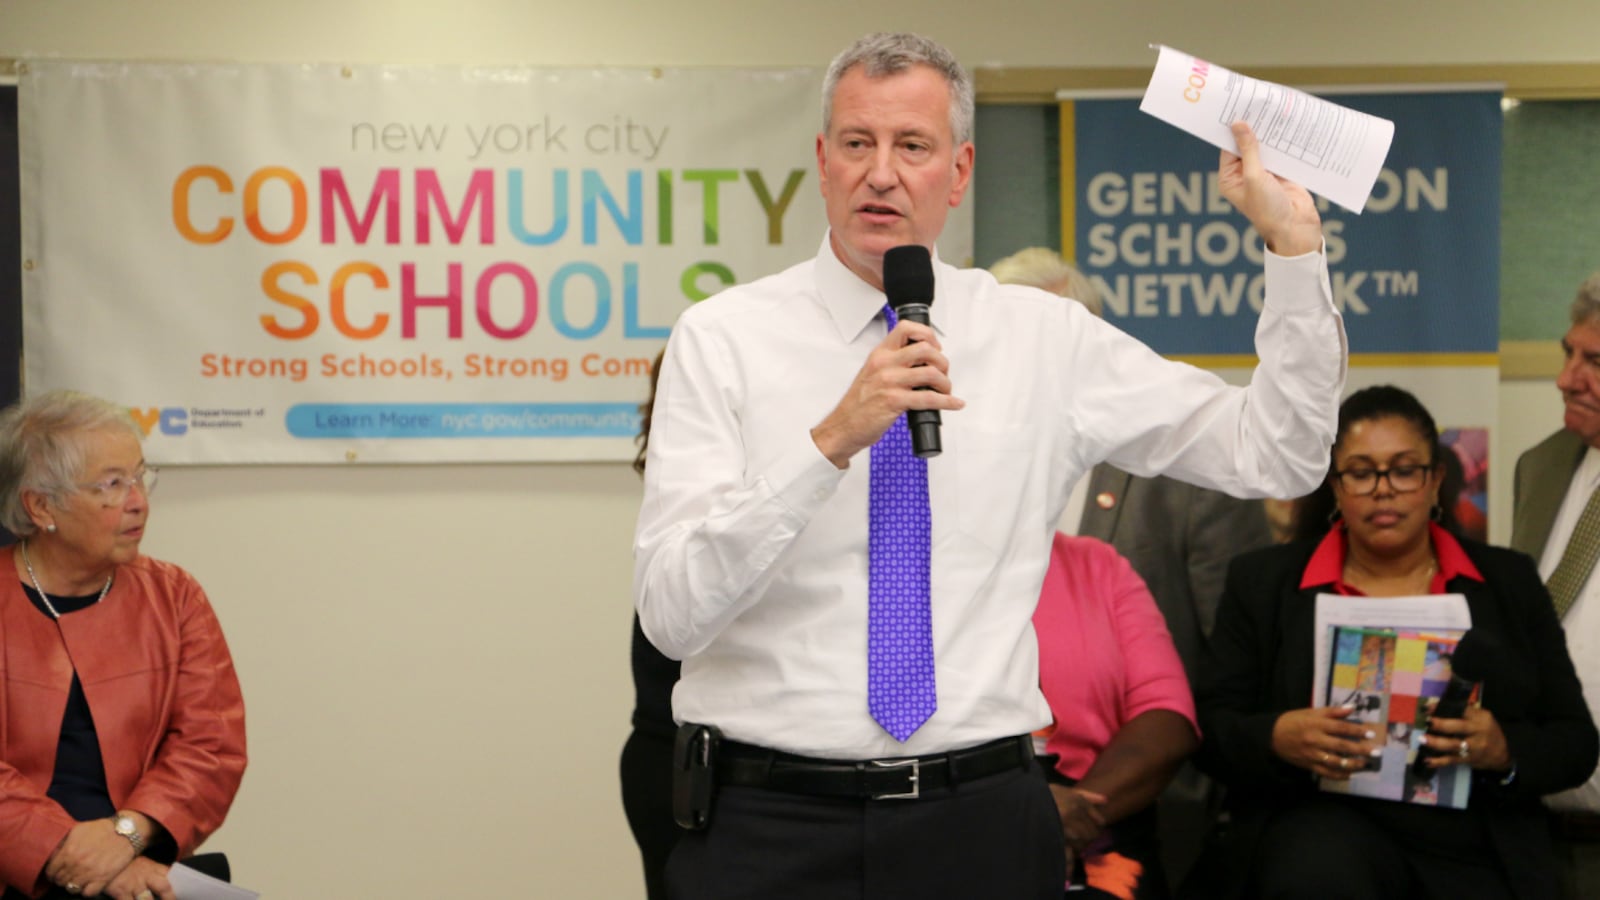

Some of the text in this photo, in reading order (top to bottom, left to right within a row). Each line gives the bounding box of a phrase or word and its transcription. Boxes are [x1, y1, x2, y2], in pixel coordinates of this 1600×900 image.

[351, 115, 670, 161] new york city
[172, 164, 807, 246] COMMUNITY
[1086, 171, 1448, 217] GENEON
[1087, 221, 1347, 267] SCHOS
[200, 353, 652, 382] Strong Schools, Strong Com
[129, 407, 188, 437] YC
[314, 411, 373, 430] Learn
[441, 411, 642, 433] nyc.gov/community
